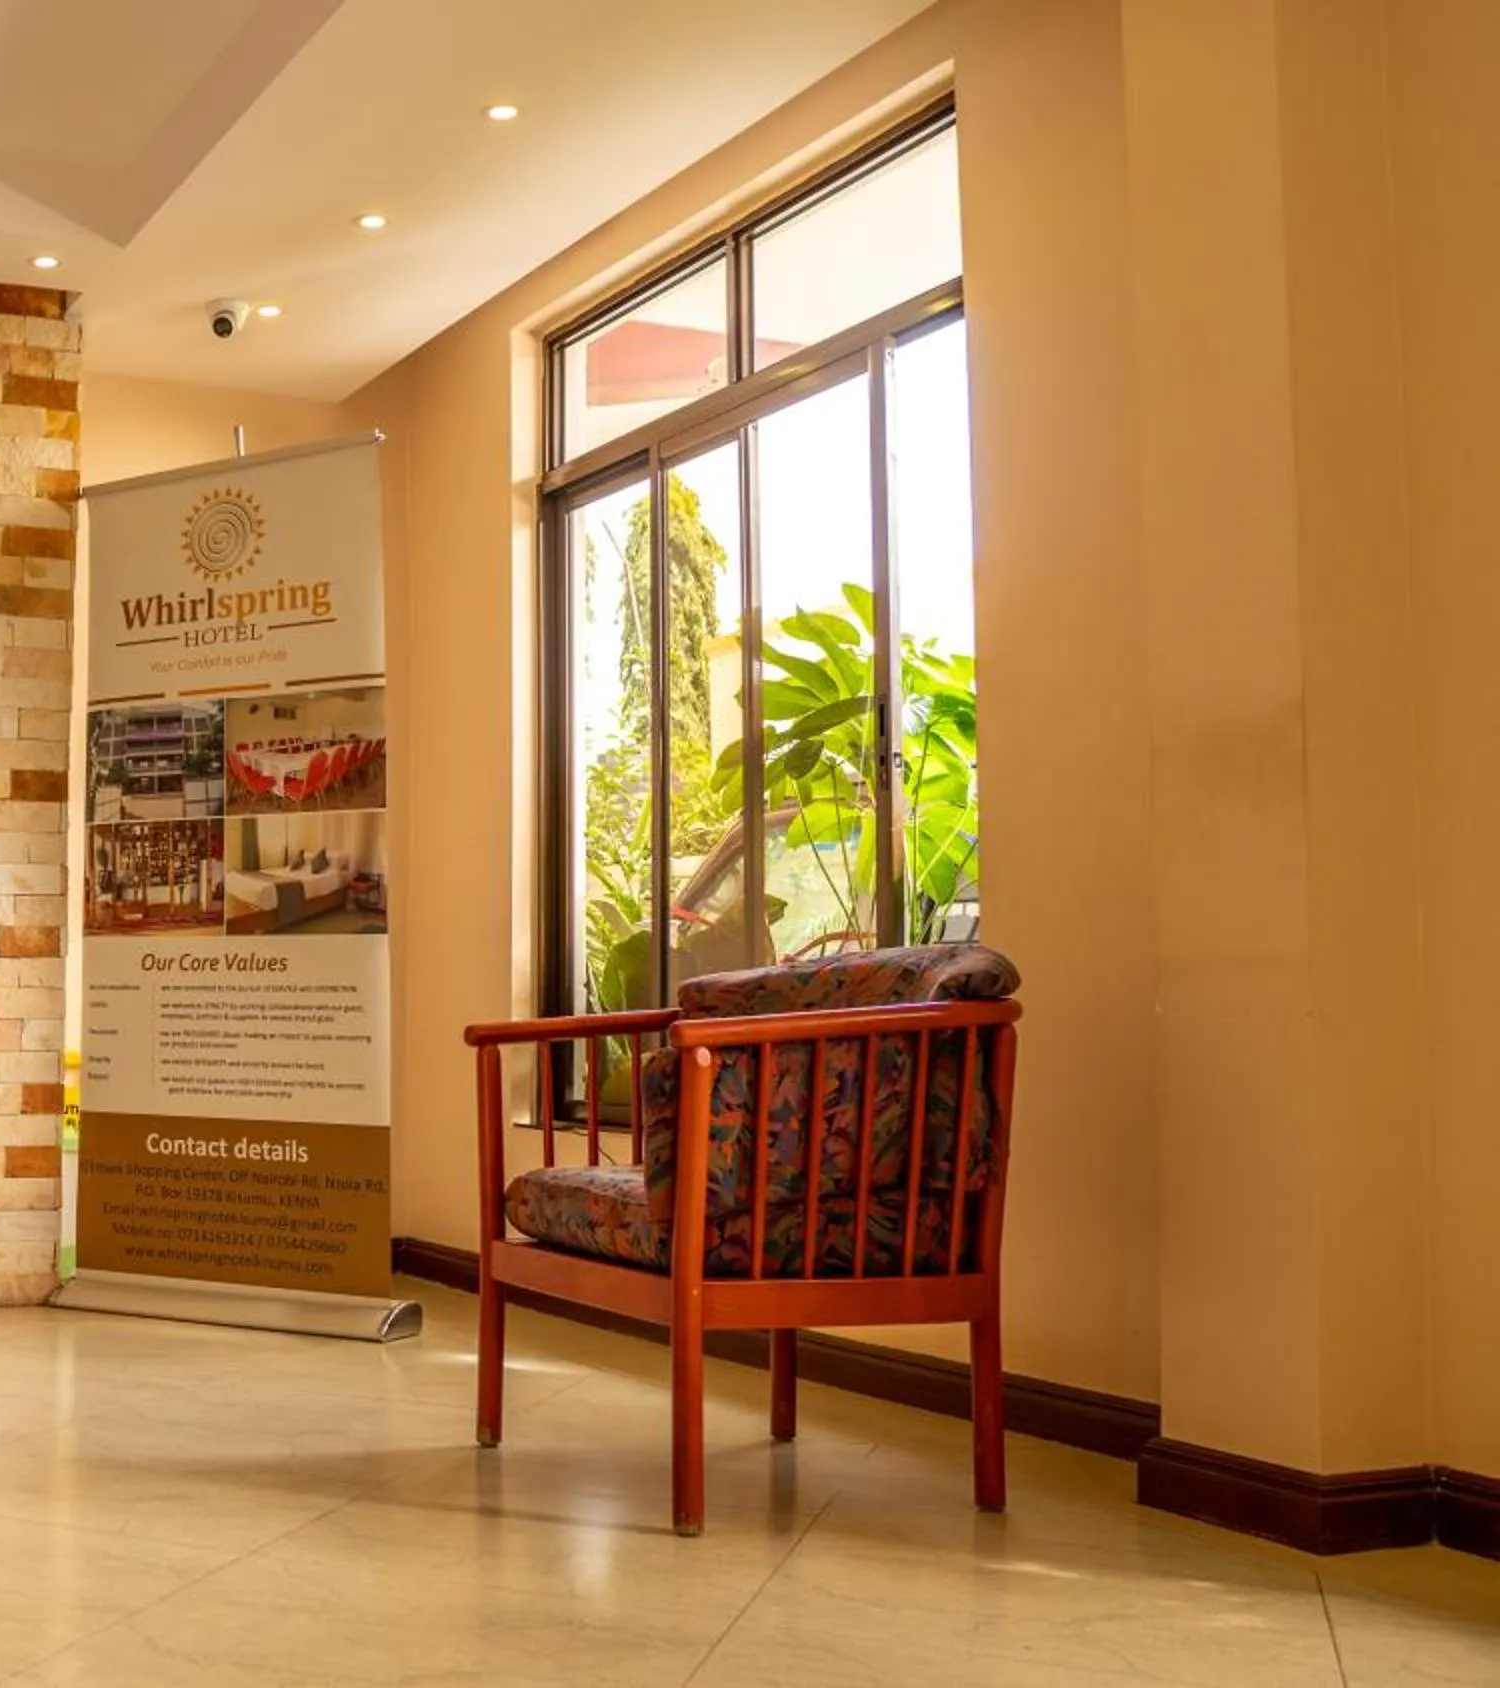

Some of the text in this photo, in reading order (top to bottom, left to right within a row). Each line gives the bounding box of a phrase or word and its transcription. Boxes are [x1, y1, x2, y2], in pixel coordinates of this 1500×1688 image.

[121, 580, 333, 631] Whirlspring
[184, 623, 264, 648] HOTEL
[141, 952, 289, 973] Our Core Values
[145, 1132, 310, 1163] Contact details
[125, 1161, 182, 1181] Shopping
[228, 1169, 249, 1183] Off
[161, 1185, 182, 1199] Box
[279, 1193, 321, 1210] KENYA
